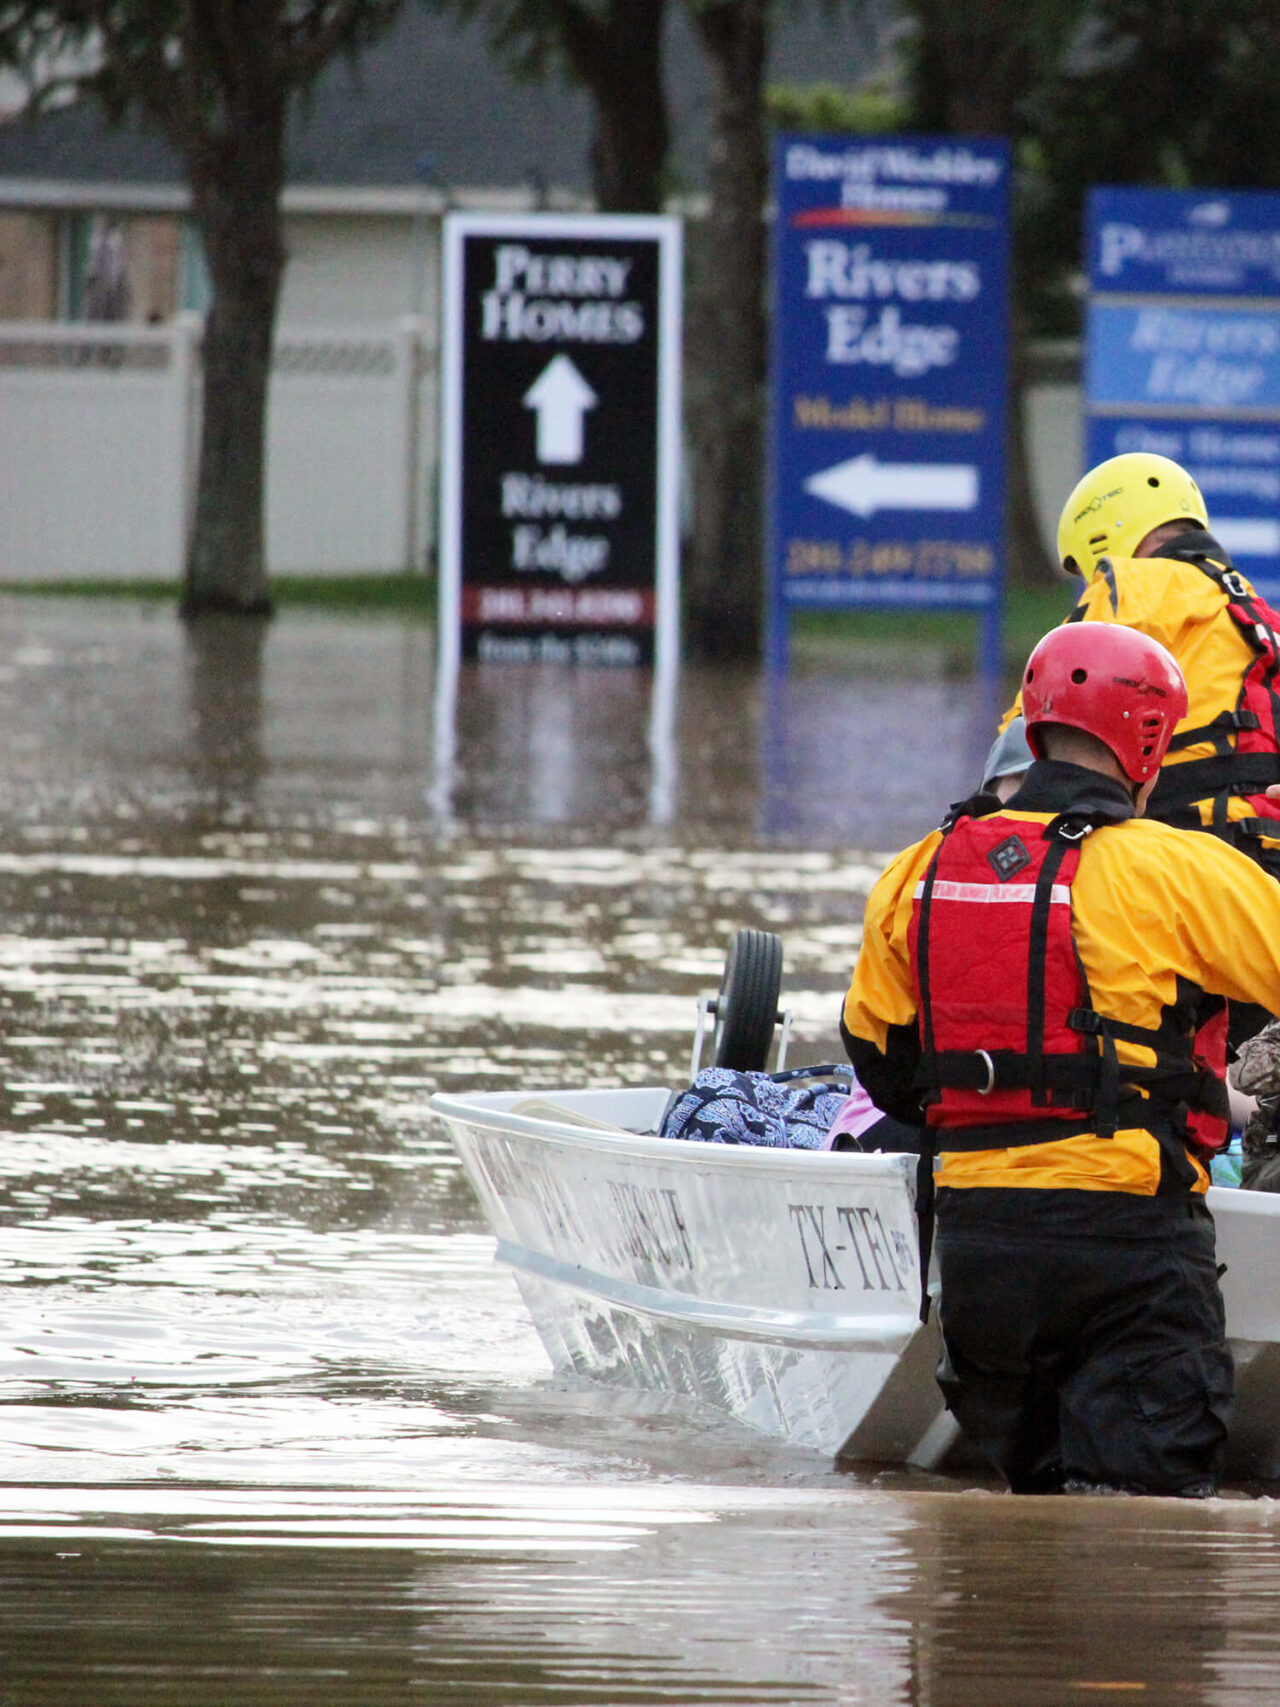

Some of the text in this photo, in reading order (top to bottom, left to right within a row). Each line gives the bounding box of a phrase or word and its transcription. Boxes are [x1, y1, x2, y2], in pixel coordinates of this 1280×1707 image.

[495, 245, 631, 296] PERRY
[807, 239, 981, 300] Rivers
[483, 294, 644, 343] HOMES
[826, 305, 959, 378] Edge
[795, 397, 887, 431] Model
[502, 473, 622, 518] Rivers
[513, 525, 609, 582] Edge
